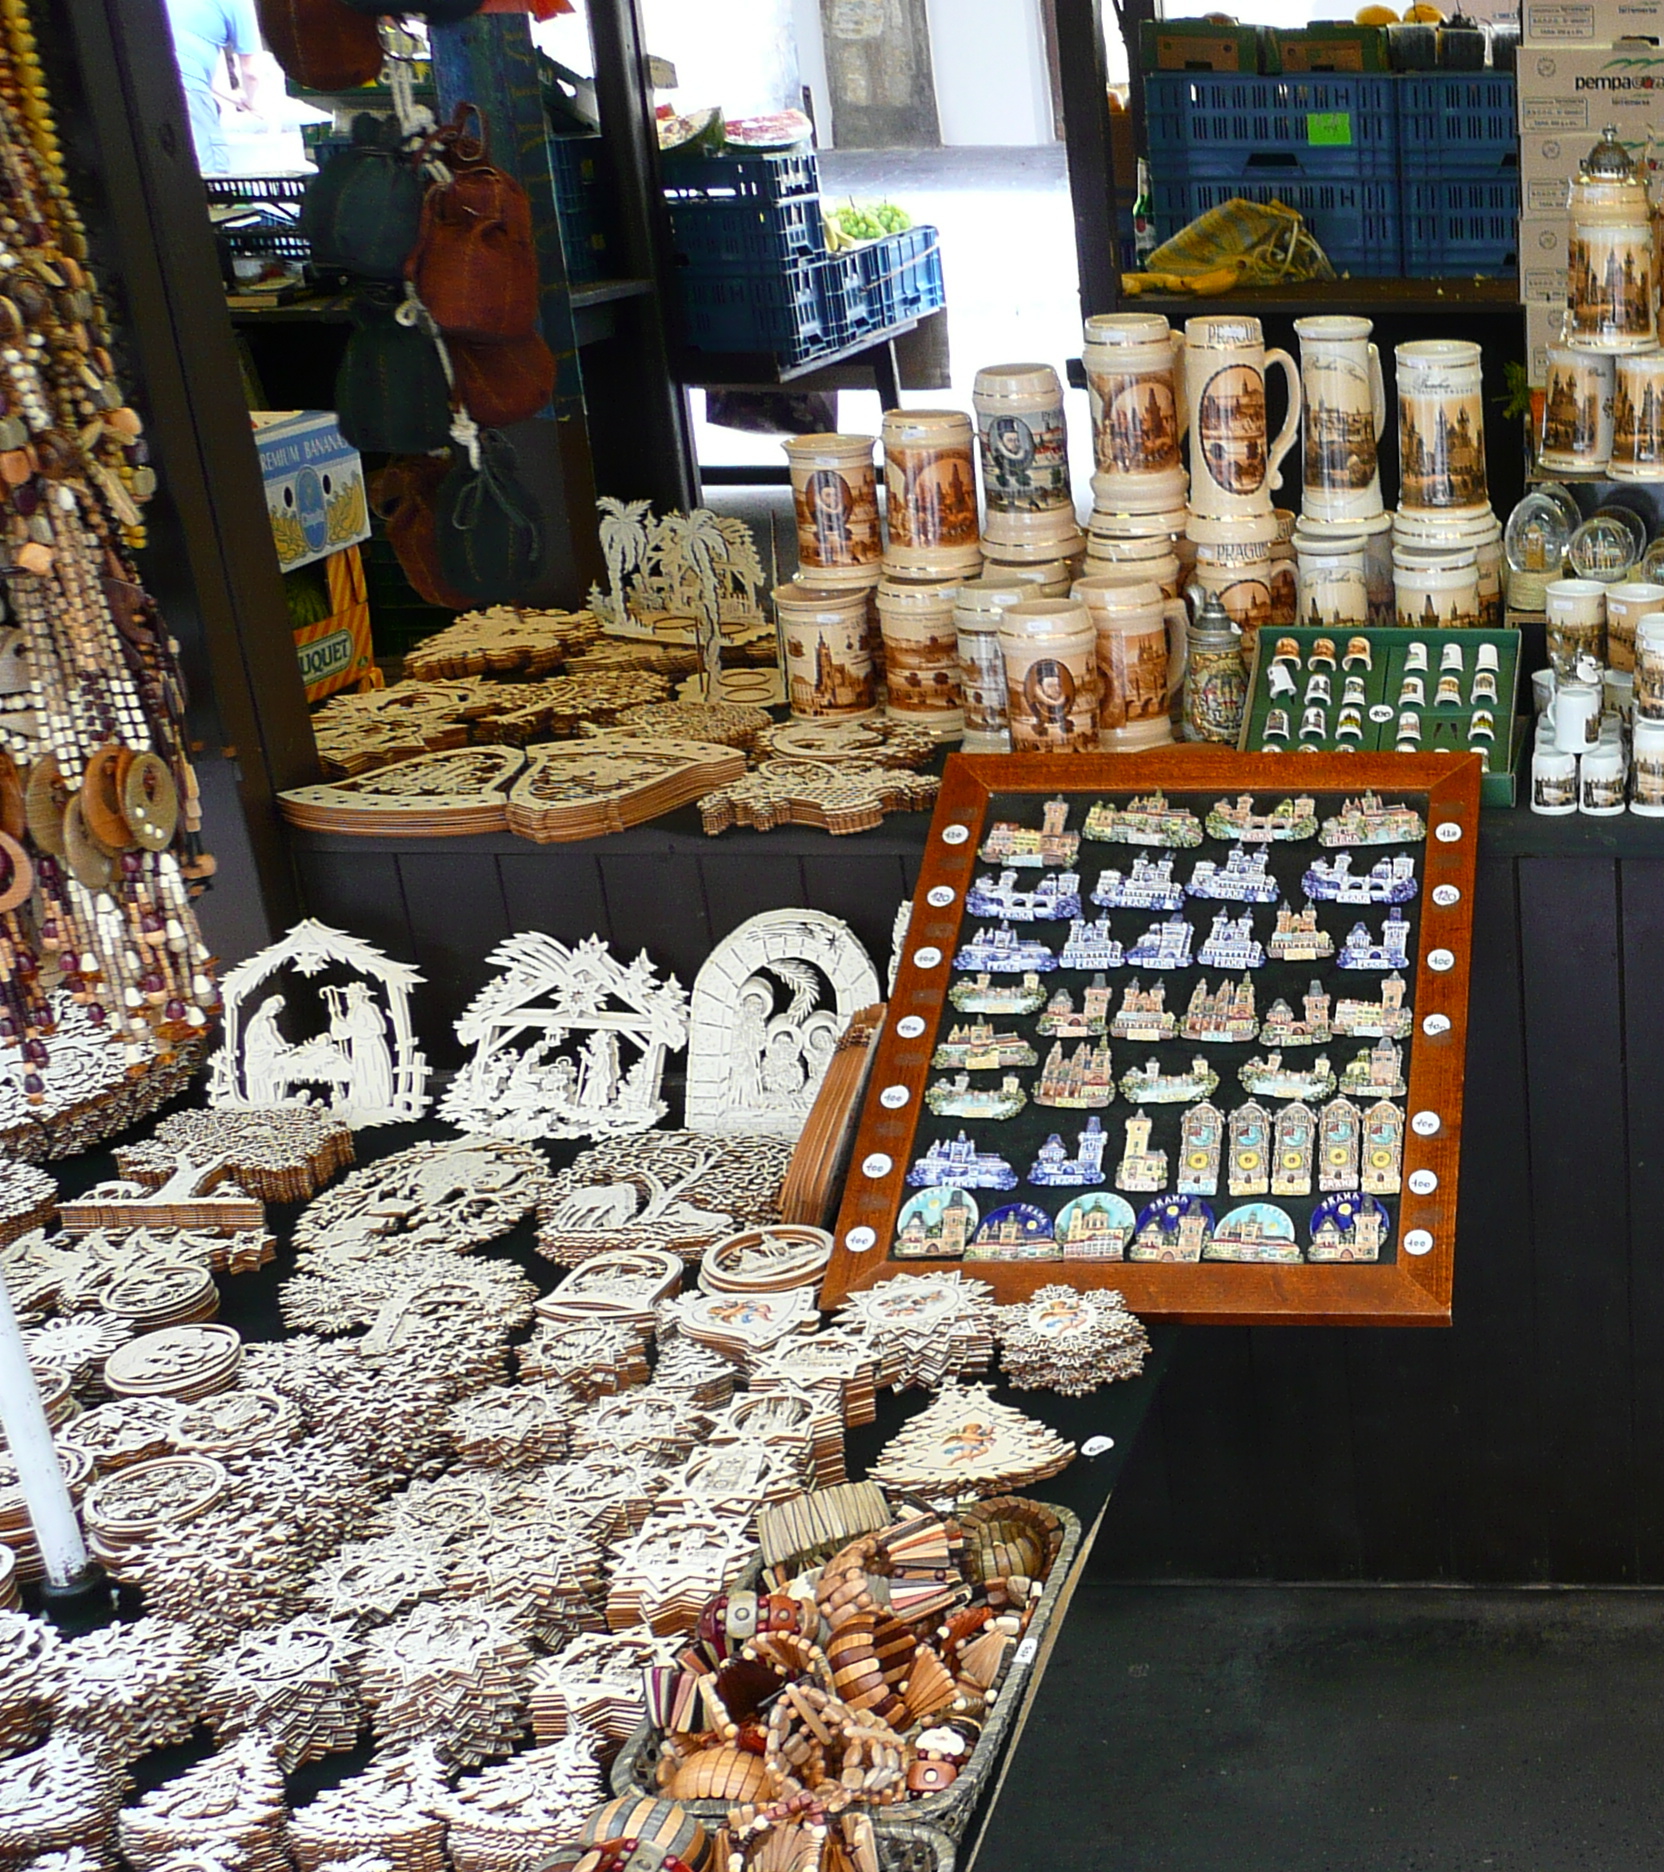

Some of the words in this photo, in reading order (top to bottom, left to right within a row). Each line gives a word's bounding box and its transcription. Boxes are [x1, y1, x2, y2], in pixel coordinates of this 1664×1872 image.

[260, 444, 301, 473] REMIUM
[299, 638, 350, 676] UQUET
[1326, 833, 1360, 846] PRAHA
[1150, 1194, 1189, 1211] PRAHA
[1320, 1192, 1360, 1210] PRAHA
[1020, 1202, 1048, 1224] PRAHA
